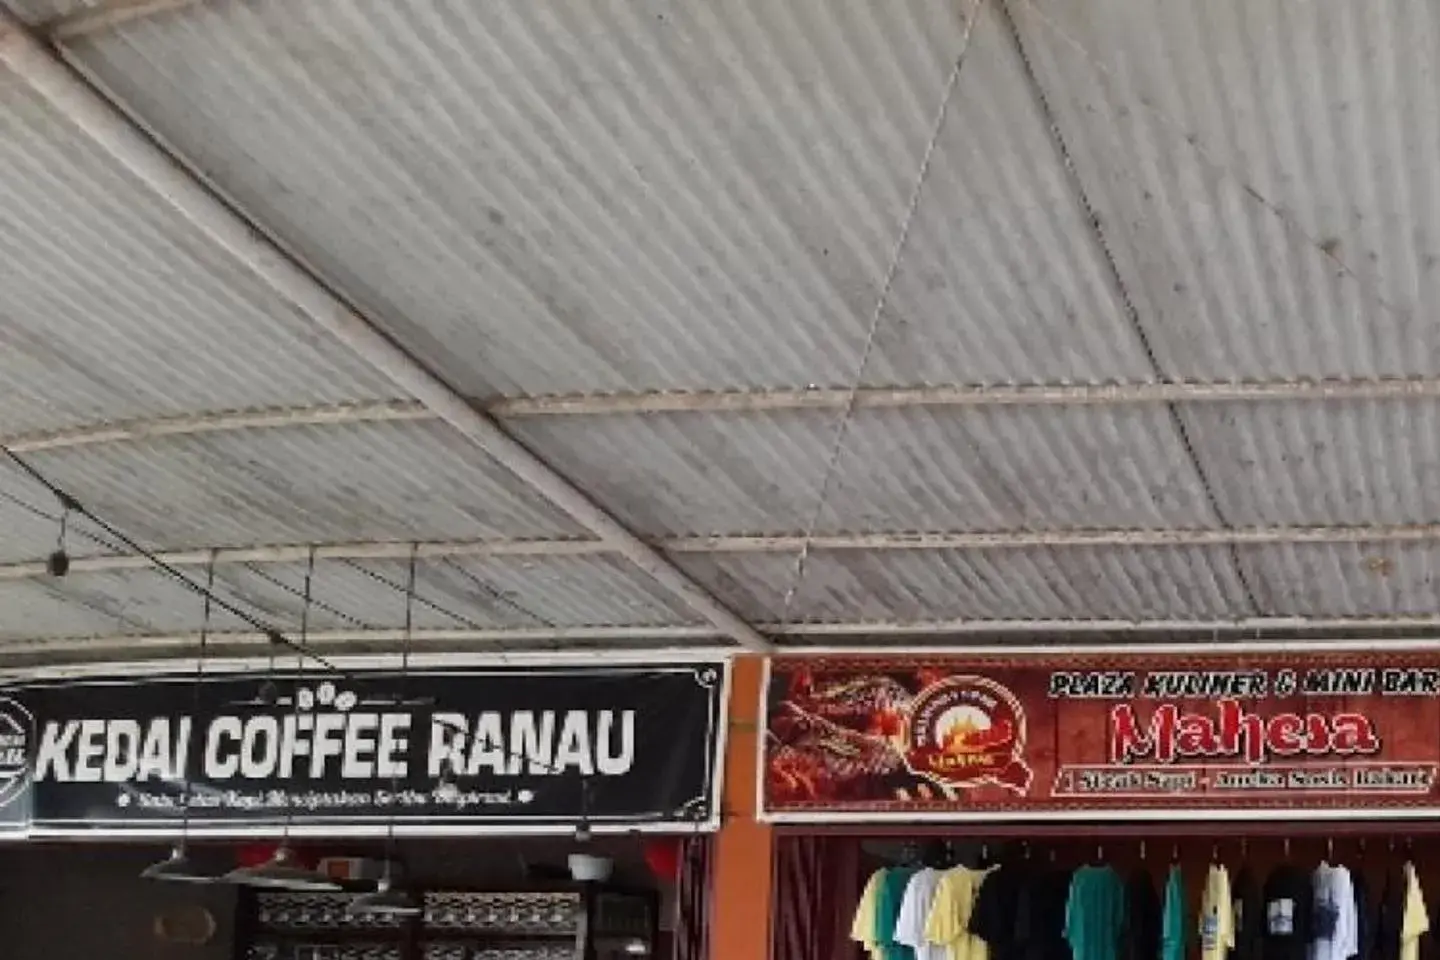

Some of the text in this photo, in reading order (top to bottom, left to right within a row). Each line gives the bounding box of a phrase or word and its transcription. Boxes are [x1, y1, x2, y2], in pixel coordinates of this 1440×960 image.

[1048, 671, 1135, 697] PLAZA
[1144, 671, 1267, 697] KULINER
[1302, 670, 1376, 695] MINI
[1382, 669, 1440, 695] BAR
[36, 714, 191, 782] KEDAI
[204, 712, 411, 780] COFFEE
[428, 709, 635, 777] RANAU
